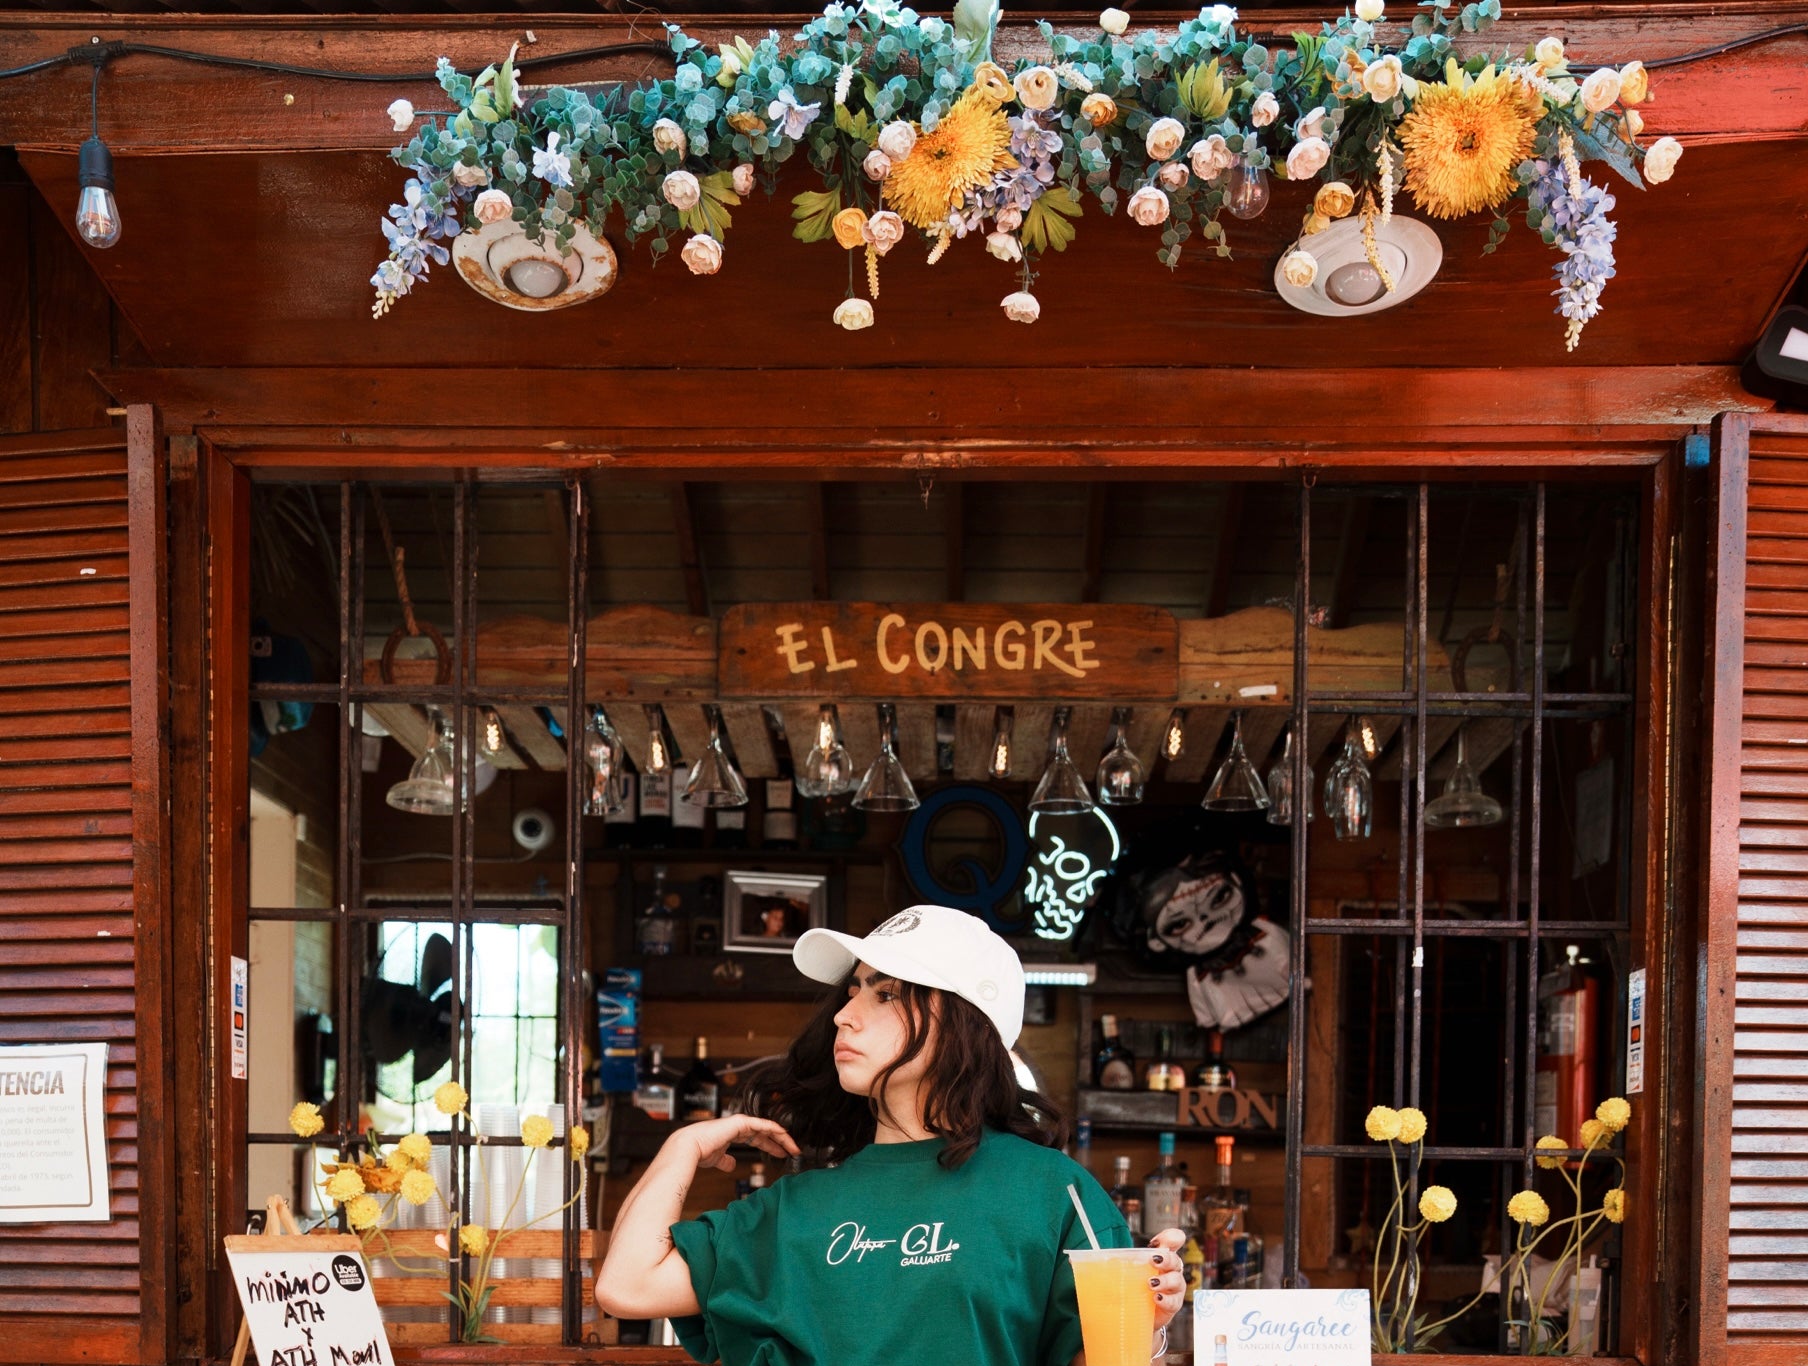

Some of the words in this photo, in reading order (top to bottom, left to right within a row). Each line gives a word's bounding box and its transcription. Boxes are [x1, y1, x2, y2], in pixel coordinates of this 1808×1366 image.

[775, 623, 857, 674] EL
[876, 613, 1101, 679] CONGRE
[1177, 1087, 1277, 1129] RON
[334, 1264, 357, 1275] Uber
[900, 1253, 953, 1267] GALUARTE
[284, 1299, 326, 1328] ATH
[1237, 1310, 1356, 1352] Sangaree
